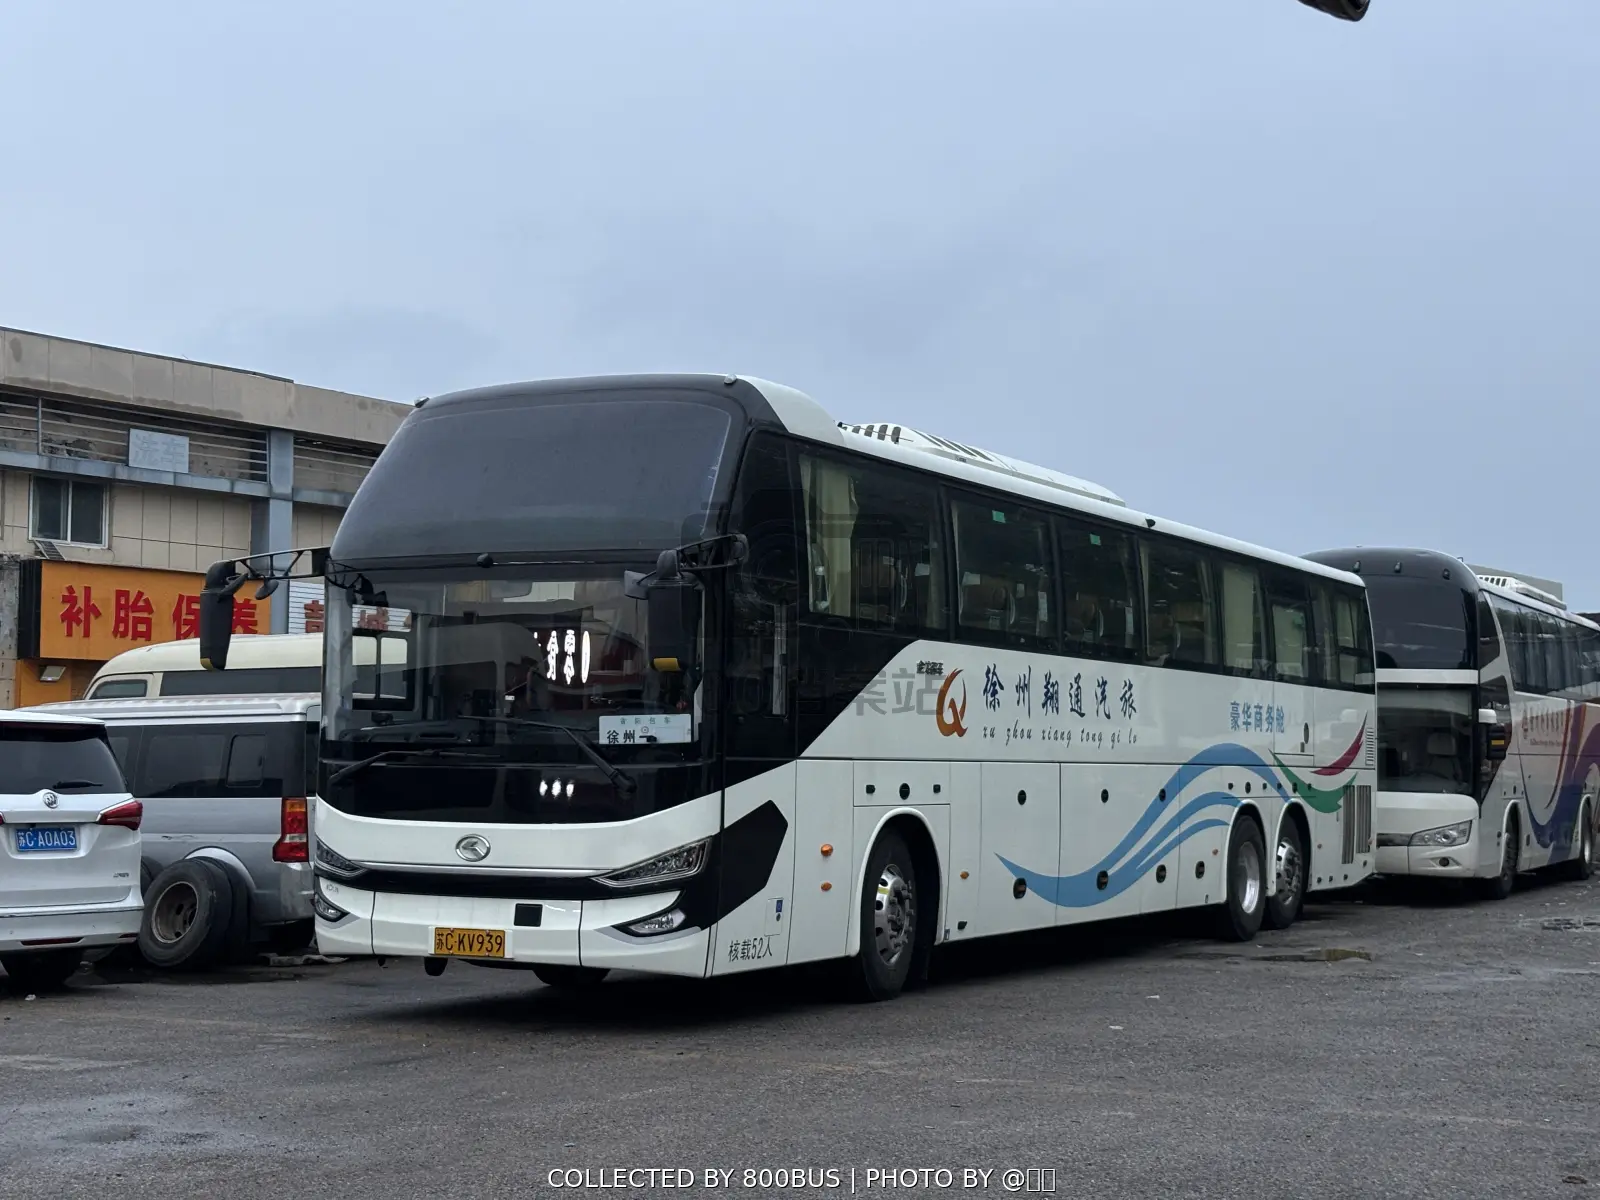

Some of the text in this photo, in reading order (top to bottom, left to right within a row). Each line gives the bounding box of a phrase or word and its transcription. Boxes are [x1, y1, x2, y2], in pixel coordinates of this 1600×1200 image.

[983, 663, 1137, 720] 徐州翔通汽旅
[1230, 701, 1285, 733] 豪华商务舱
[606, 729, 636, 744] 徐州
[1006, 719, 1032, 746] zhou
[1041, 726, 1072, 748] xiang
[728, 936, 773, 962] 核载52人
